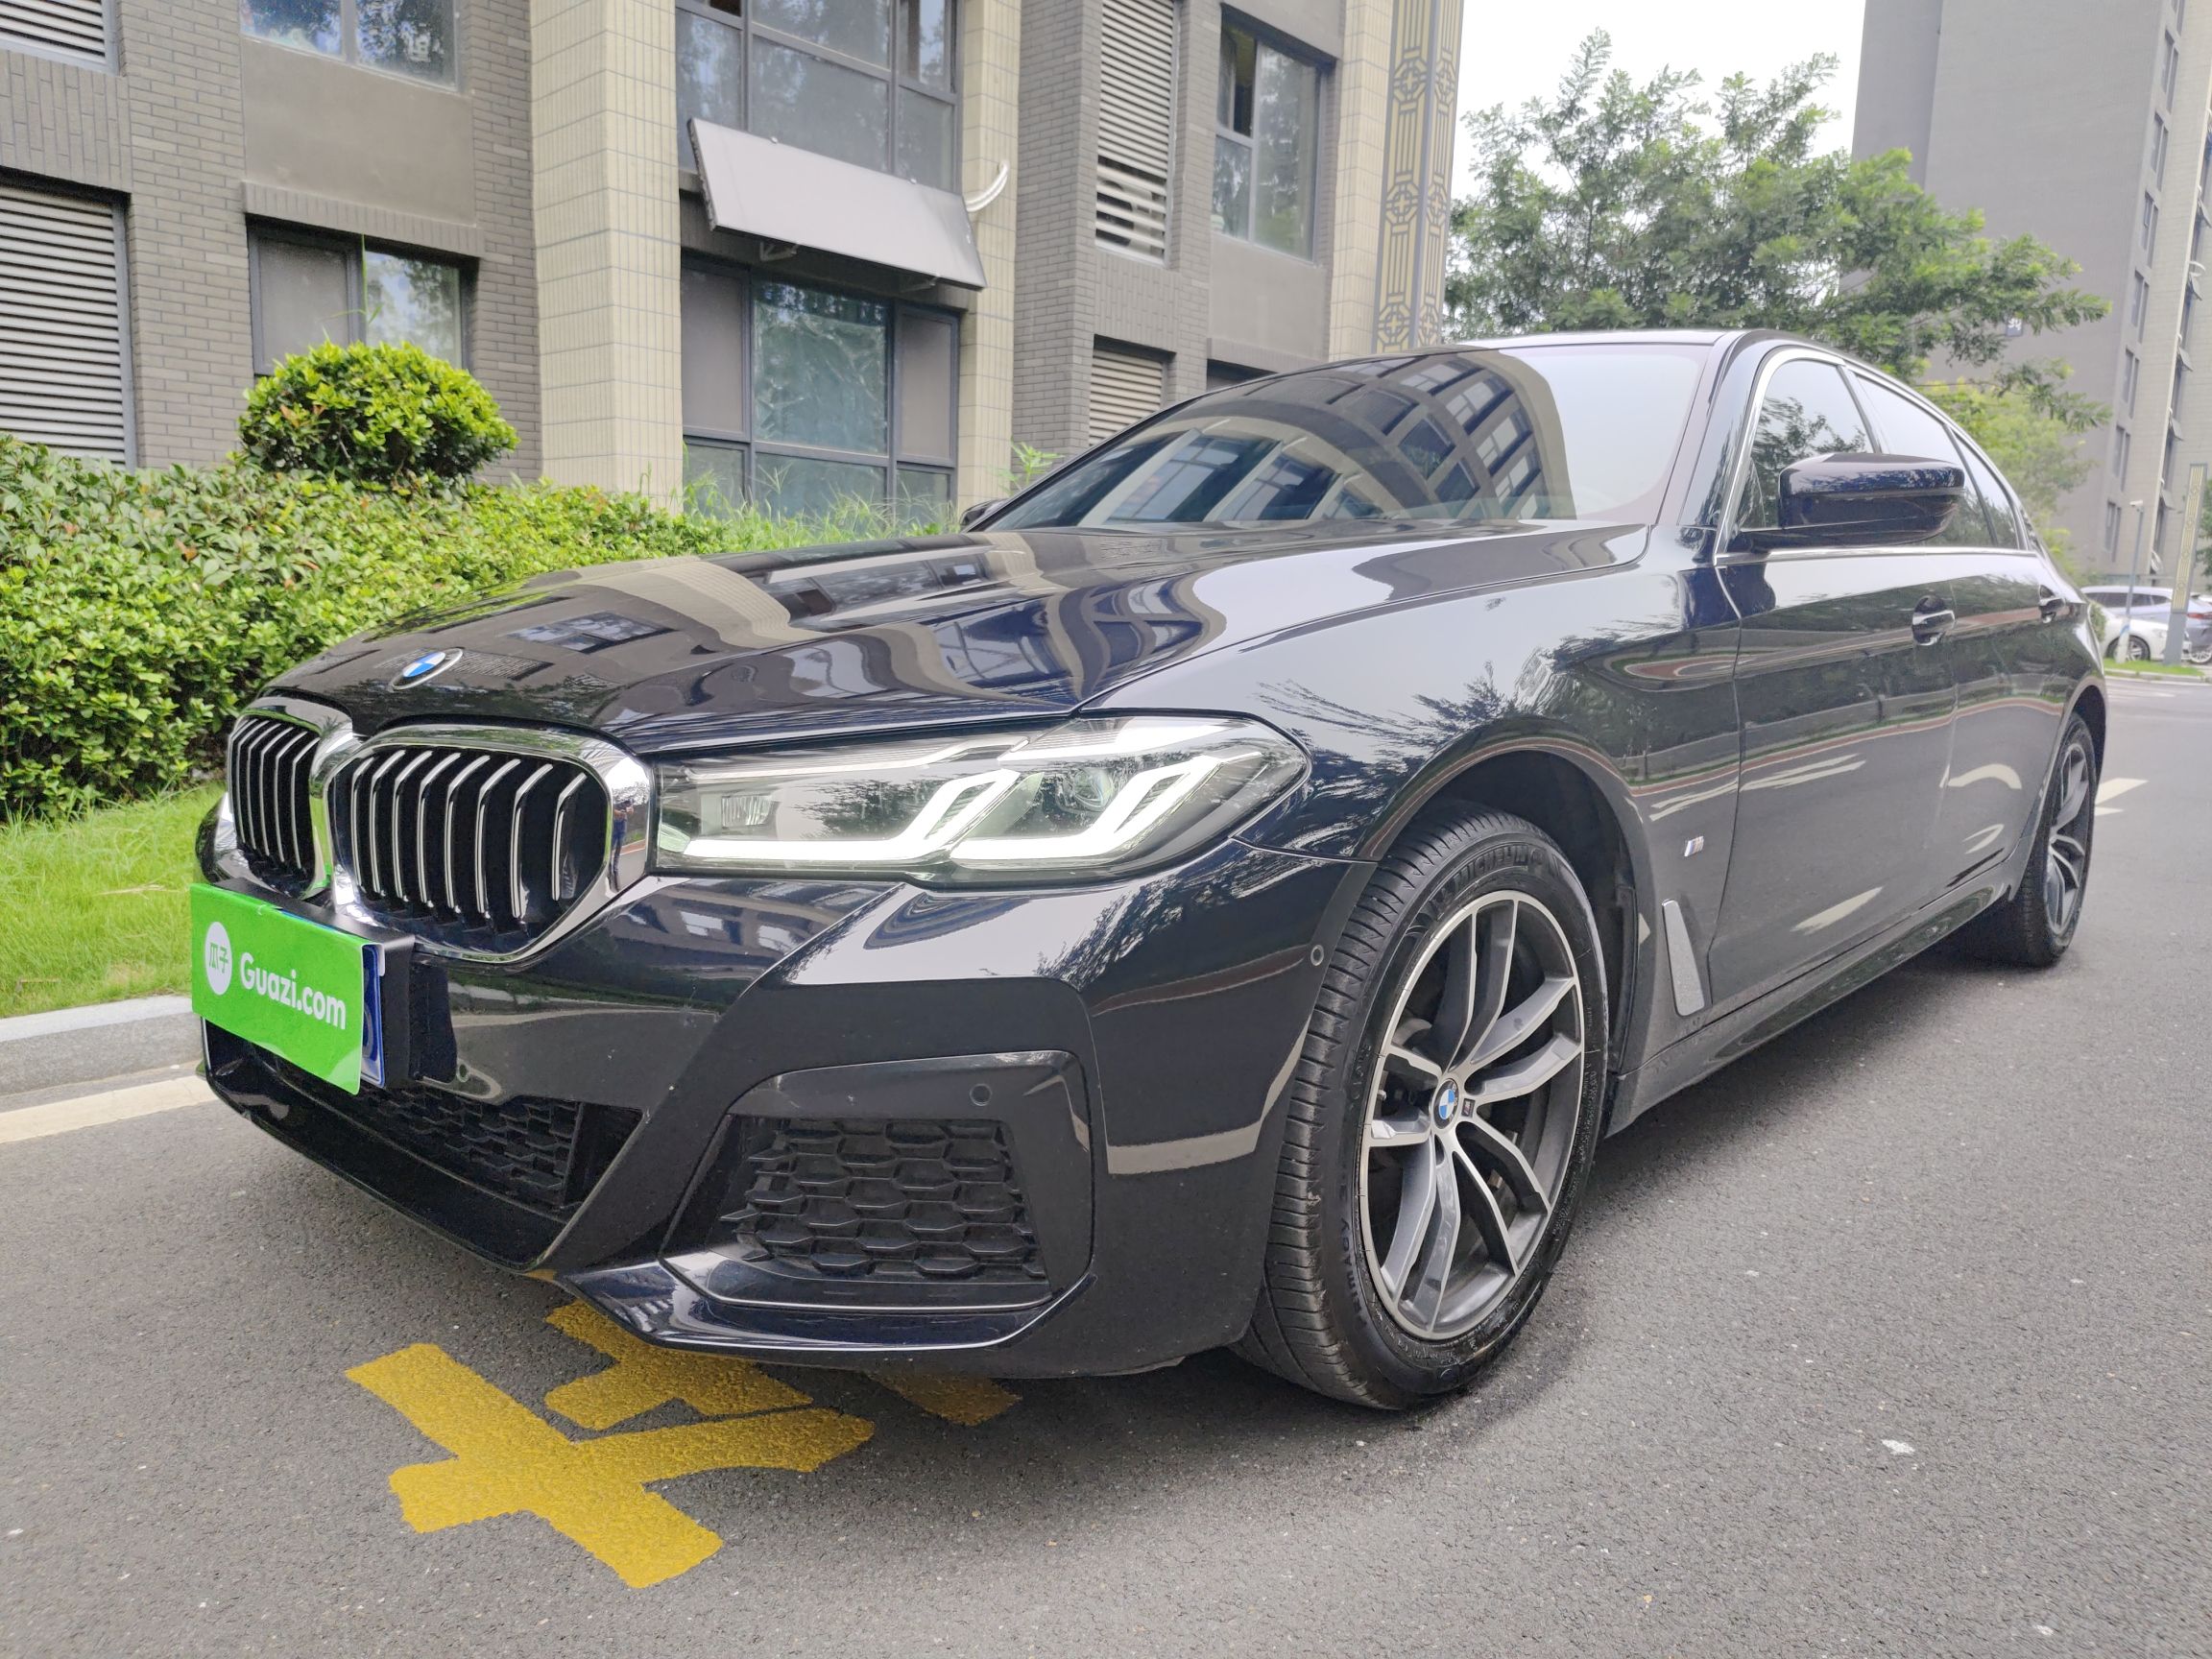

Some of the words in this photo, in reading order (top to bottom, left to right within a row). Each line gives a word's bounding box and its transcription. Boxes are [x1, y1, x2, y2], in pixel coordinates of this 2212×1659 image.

[1453, 845, 1528, 896] MICHELIN
[209, 942, 228, 974] 瓜子
[240, 951, 346, 1030] Guazi.com
